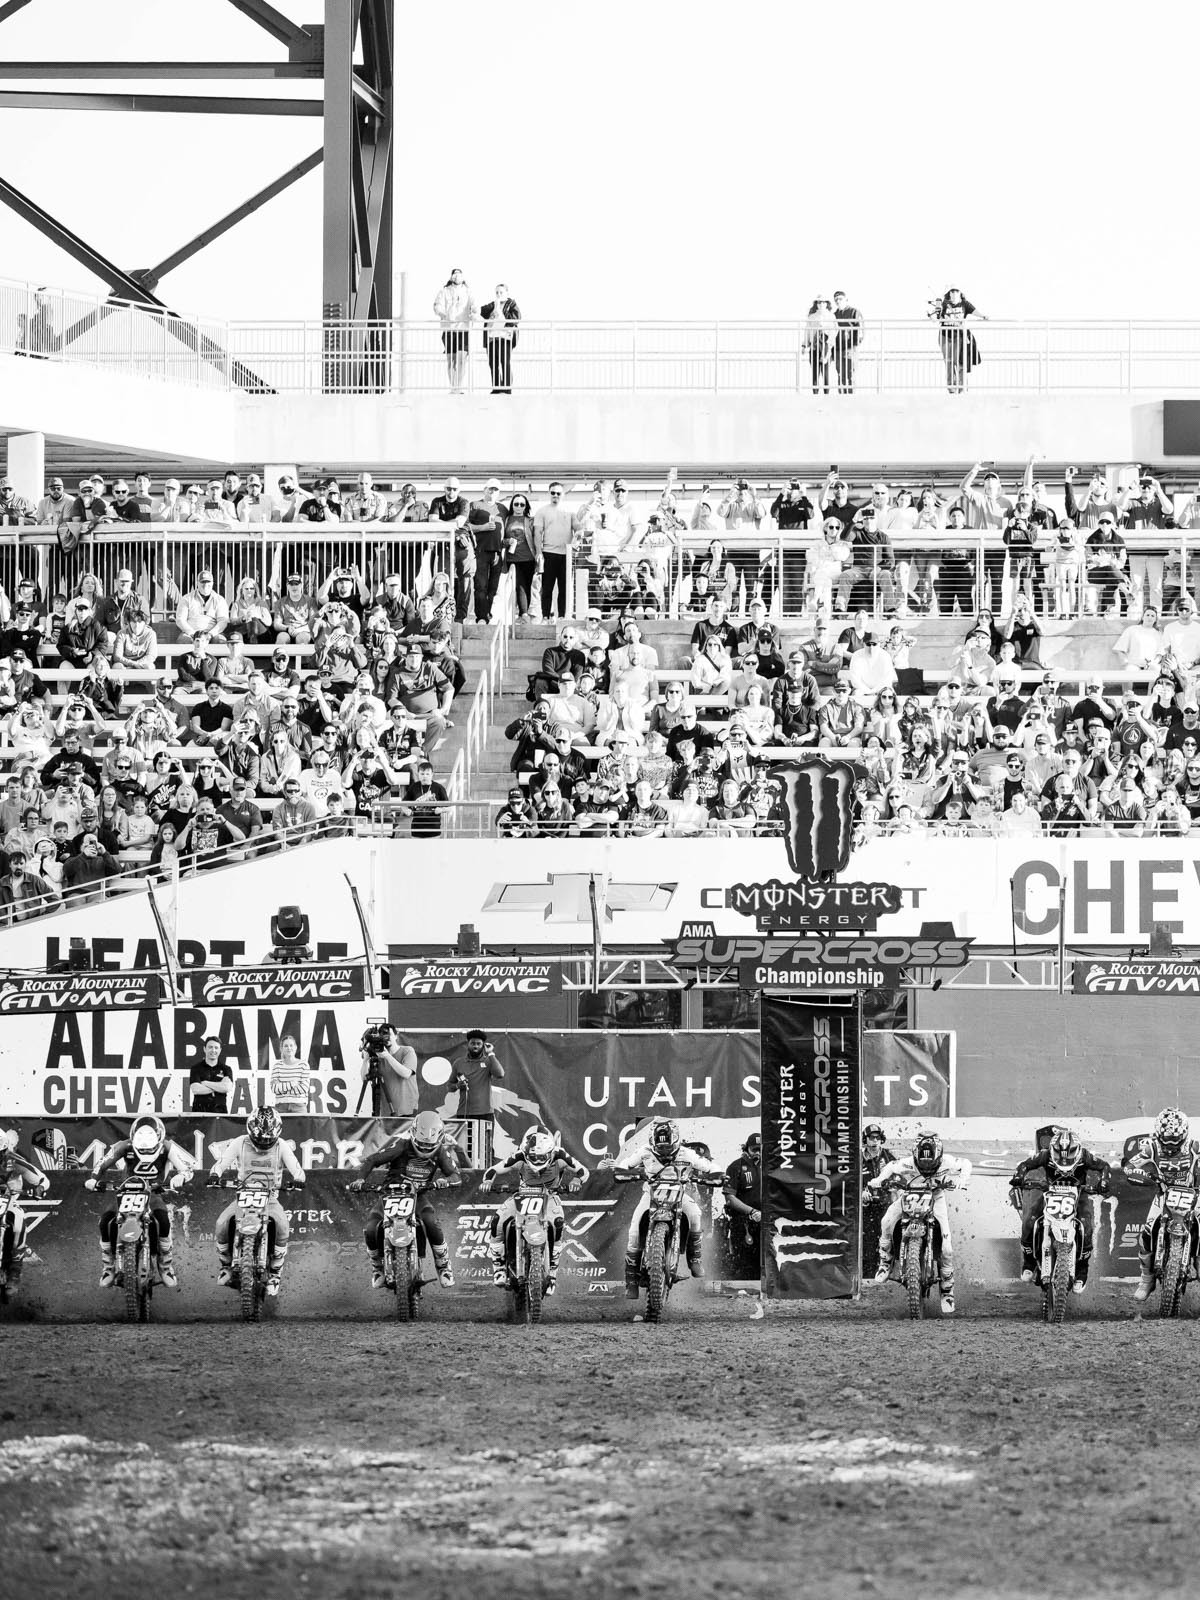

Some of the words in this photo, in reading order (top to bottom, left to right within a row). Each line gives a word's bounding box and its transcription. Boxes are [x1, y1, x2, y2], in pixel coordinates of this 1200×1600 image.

[735, 883, 892, 911] MONSTER
[761, 914, 868, 925] ENERGY
[682, 924, 714, 938] AMA
[673, 939, 969, 964] SUPERCROSS
[226, 971, 274, 984] ROCKY
[274, 969, 353, 983] MOUNTAIN
[424, 965, 472, 978] ROCKY
[472, 964, 551, 977] MOUNTAIN
[754, 966, 885, 987] Championship
[1108, 962, 1156, 975] ROCKY
[21, 979, 68, 992] ROCKY
[70, 977, 148, 991] MOUNTAIN
[46, 1008, 347, 1071] ALABAMA
[43, 1075, 171, 1115] CHEVY
[584, 1076, 712, 1108] UTAH
[780, 1063, 797, 1170] MONSTER
[813, 1016, 831, 1216] SUPERCROSS
[837, 1059, 849, 1174] CHAMPIONSHIP
[119, 1194, 148, 1213] 89
[237, 1191, 268, 1208] 55
[384, 1198, 414, 1217] 59
[519, 1197, 544, 1215] 10
[804, 1187, 815, 1210] AMA
[905, 1193, 933, 1210] 34
[1046, 1196, 1075, 1215] 56
[1166, 1190, 1195, 1209] 92
